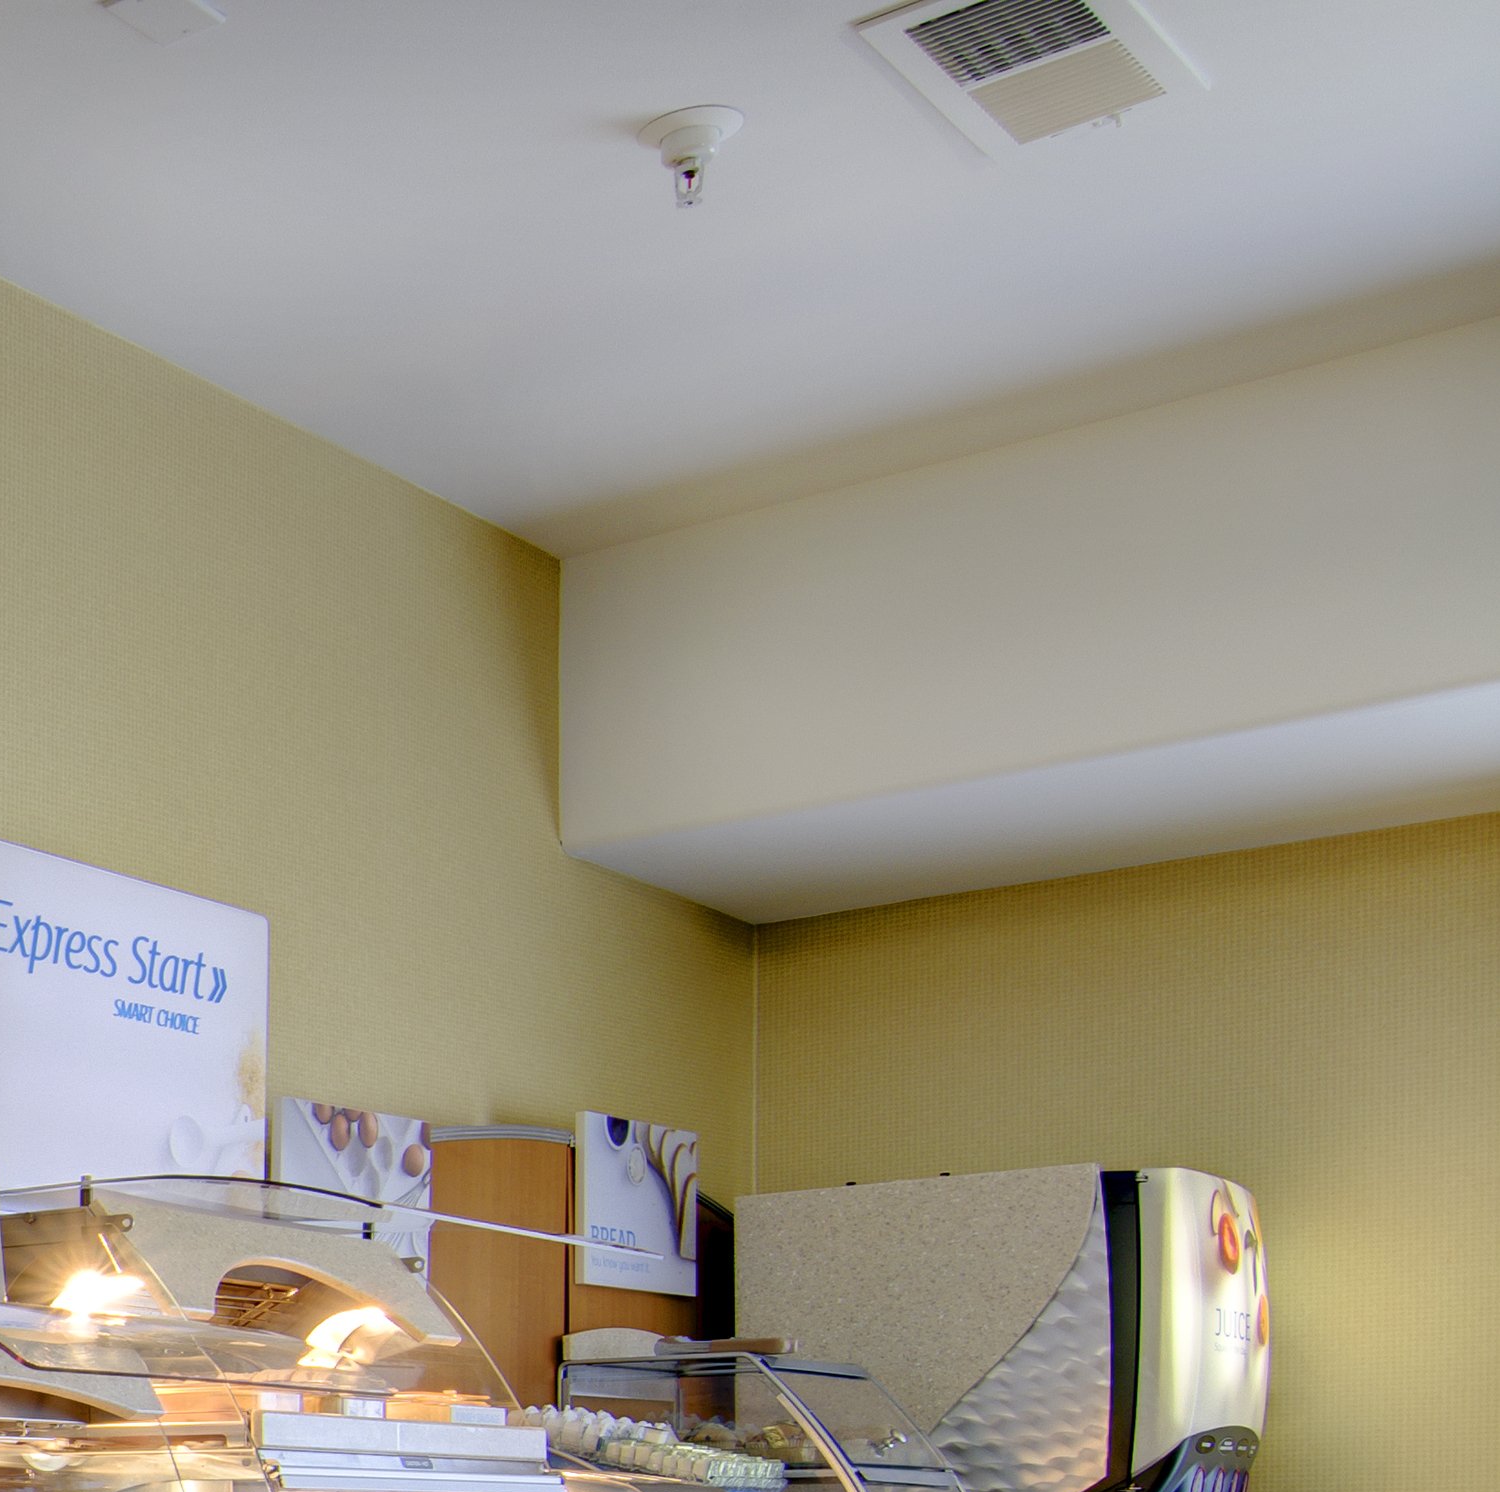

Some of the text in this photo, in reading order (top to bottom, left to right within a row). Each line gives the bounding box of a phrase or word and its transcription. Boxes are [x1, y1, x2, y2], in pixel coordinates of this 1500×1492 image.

[127, 935, 207, 1000] Start
[113, 999, 200, 1035] SMART CHOICE
[1215, 1307, 1251, 1341] JUICE
